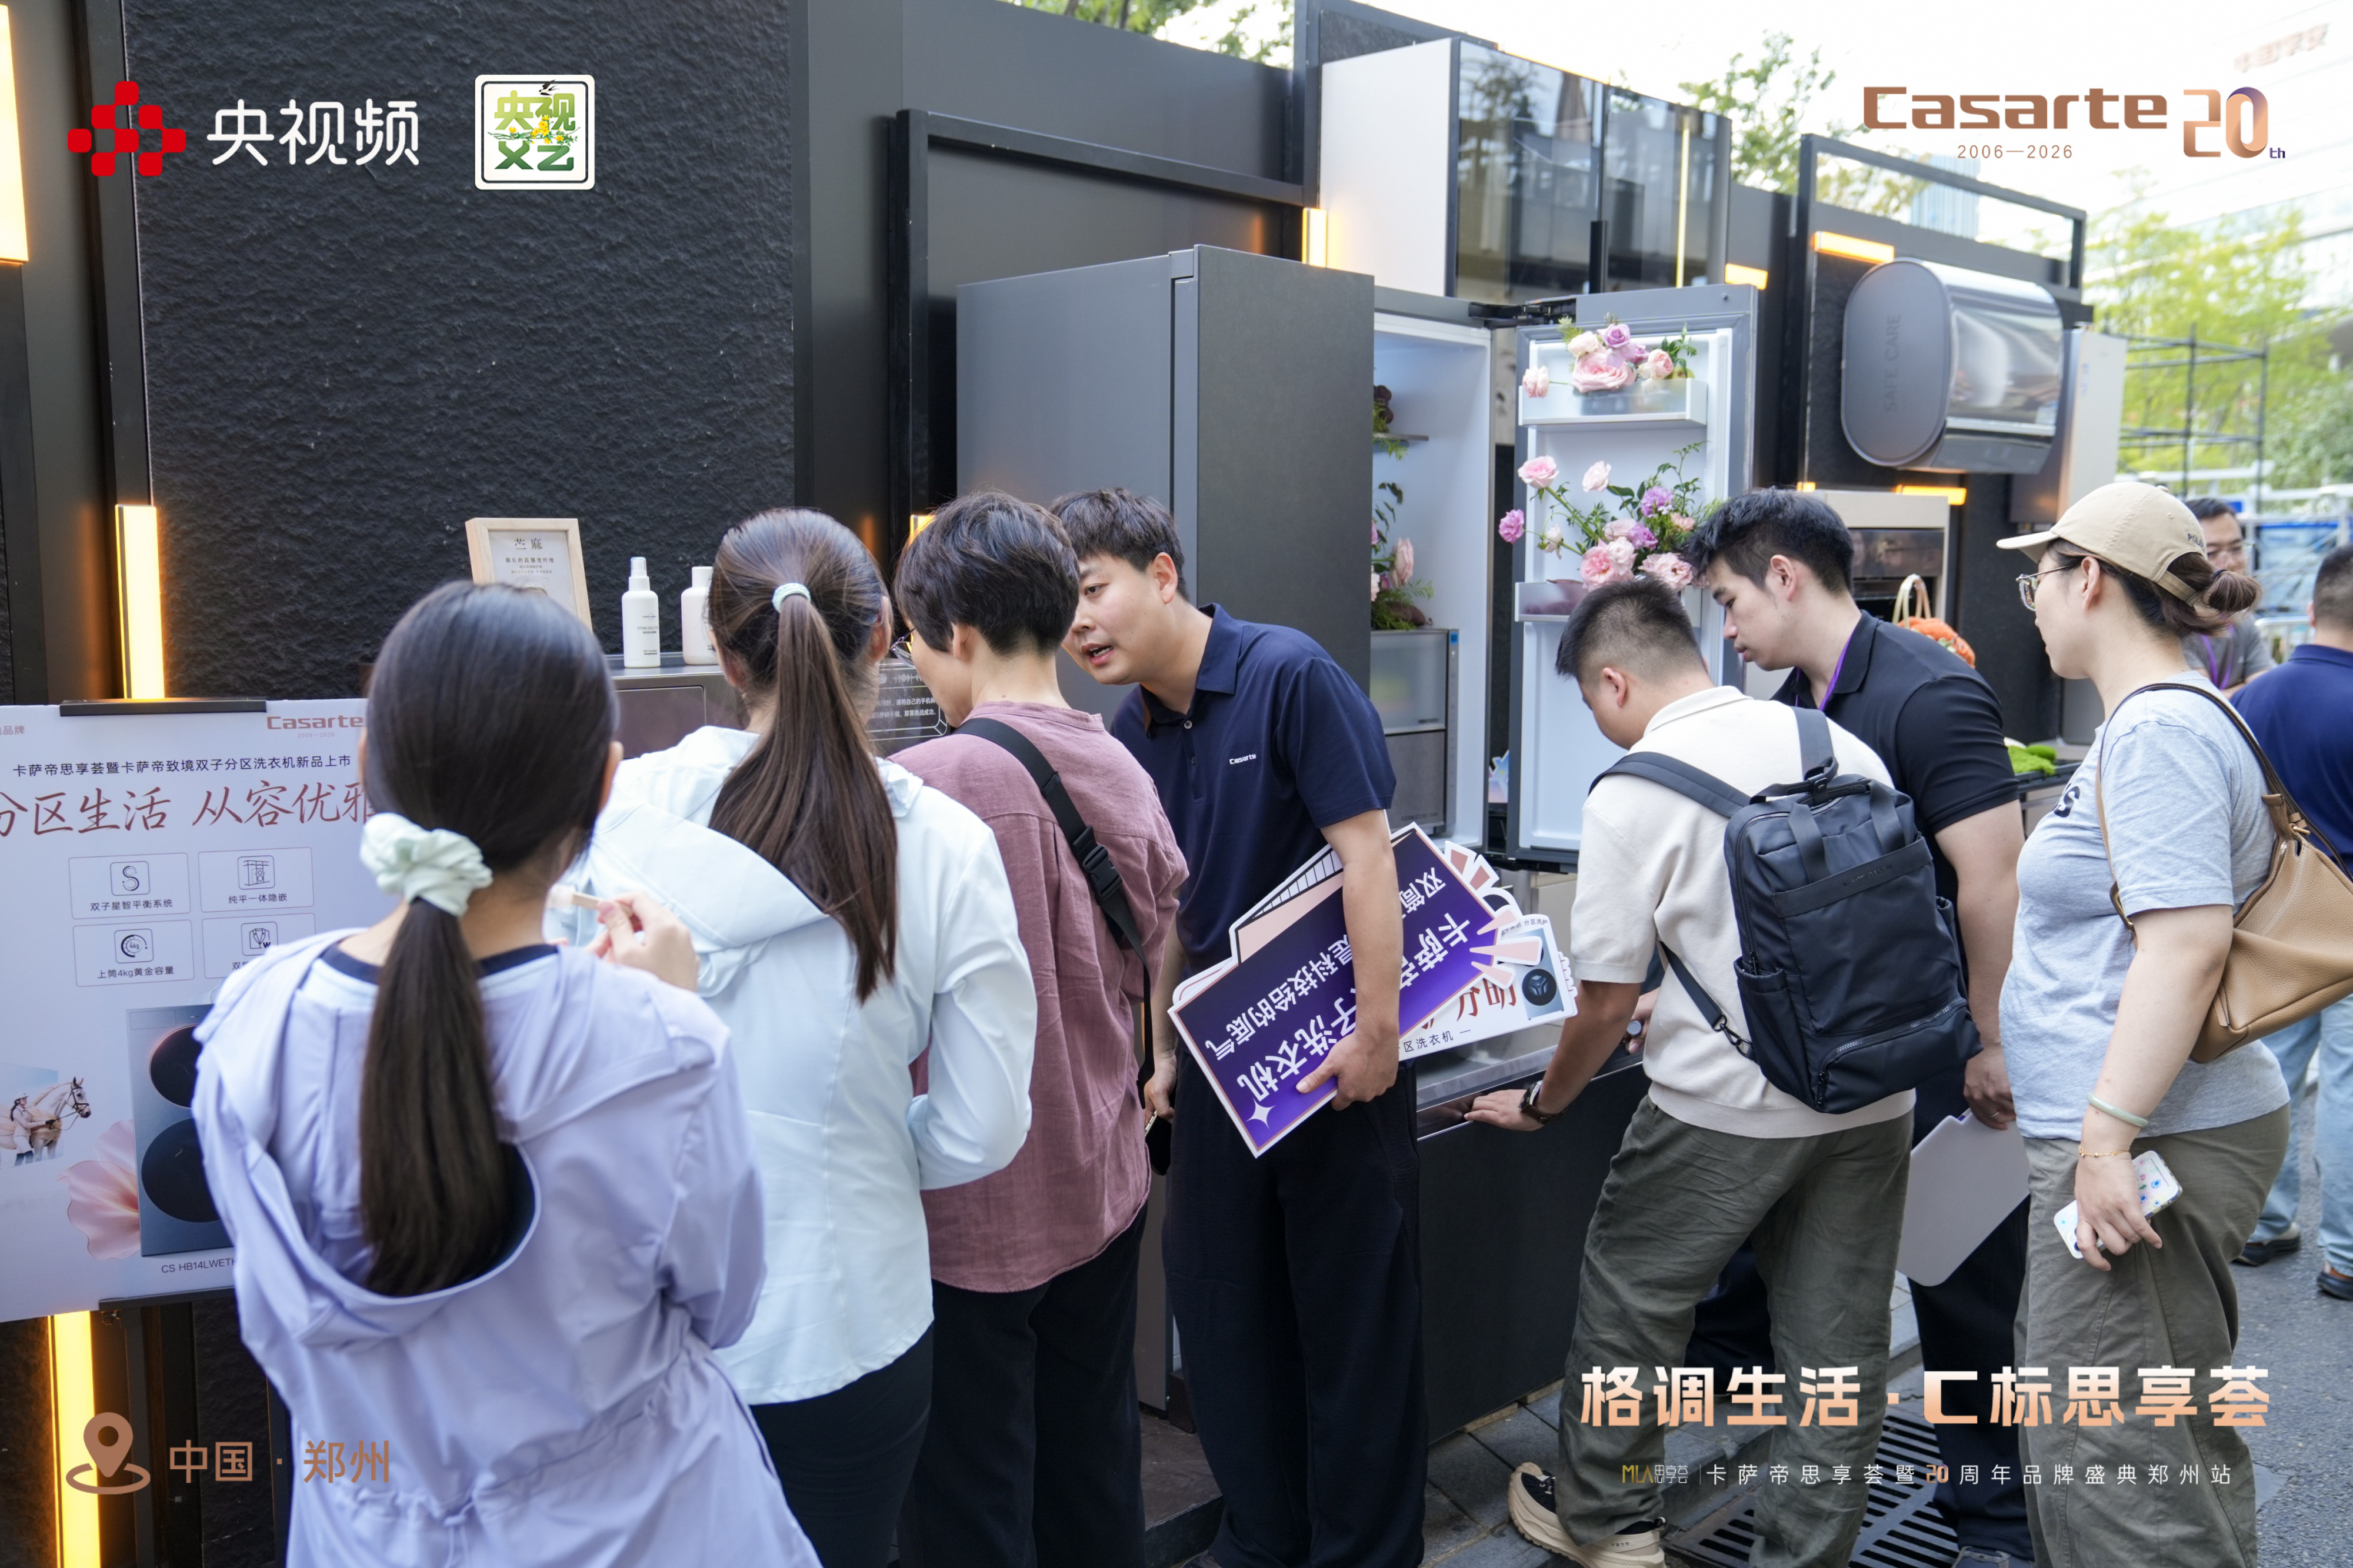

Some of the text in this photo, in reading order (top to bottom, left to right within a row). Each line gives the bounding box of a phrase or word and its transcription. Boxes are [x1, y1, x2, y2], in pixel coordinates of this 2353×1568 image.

[2187, 533, 2203, 548] POLO
[266, 715, 364, 730] Casarte
[0, 725, 25, 735] 品牌
[13, 755, 351, 777] 卡萨帝思享荟暨卡萨帝致境双子分区洗衣机新品上市
[1229, 754, 1257, 765] Casarte
[228, 892, 288, 904] 纯平一体隐嵌
[90, 899, 173, 912] 双子星智平衡系统
[97, 966, 174, 979] 上筒4kg黄金容量
[161, 1264, 175, 1273] CS
